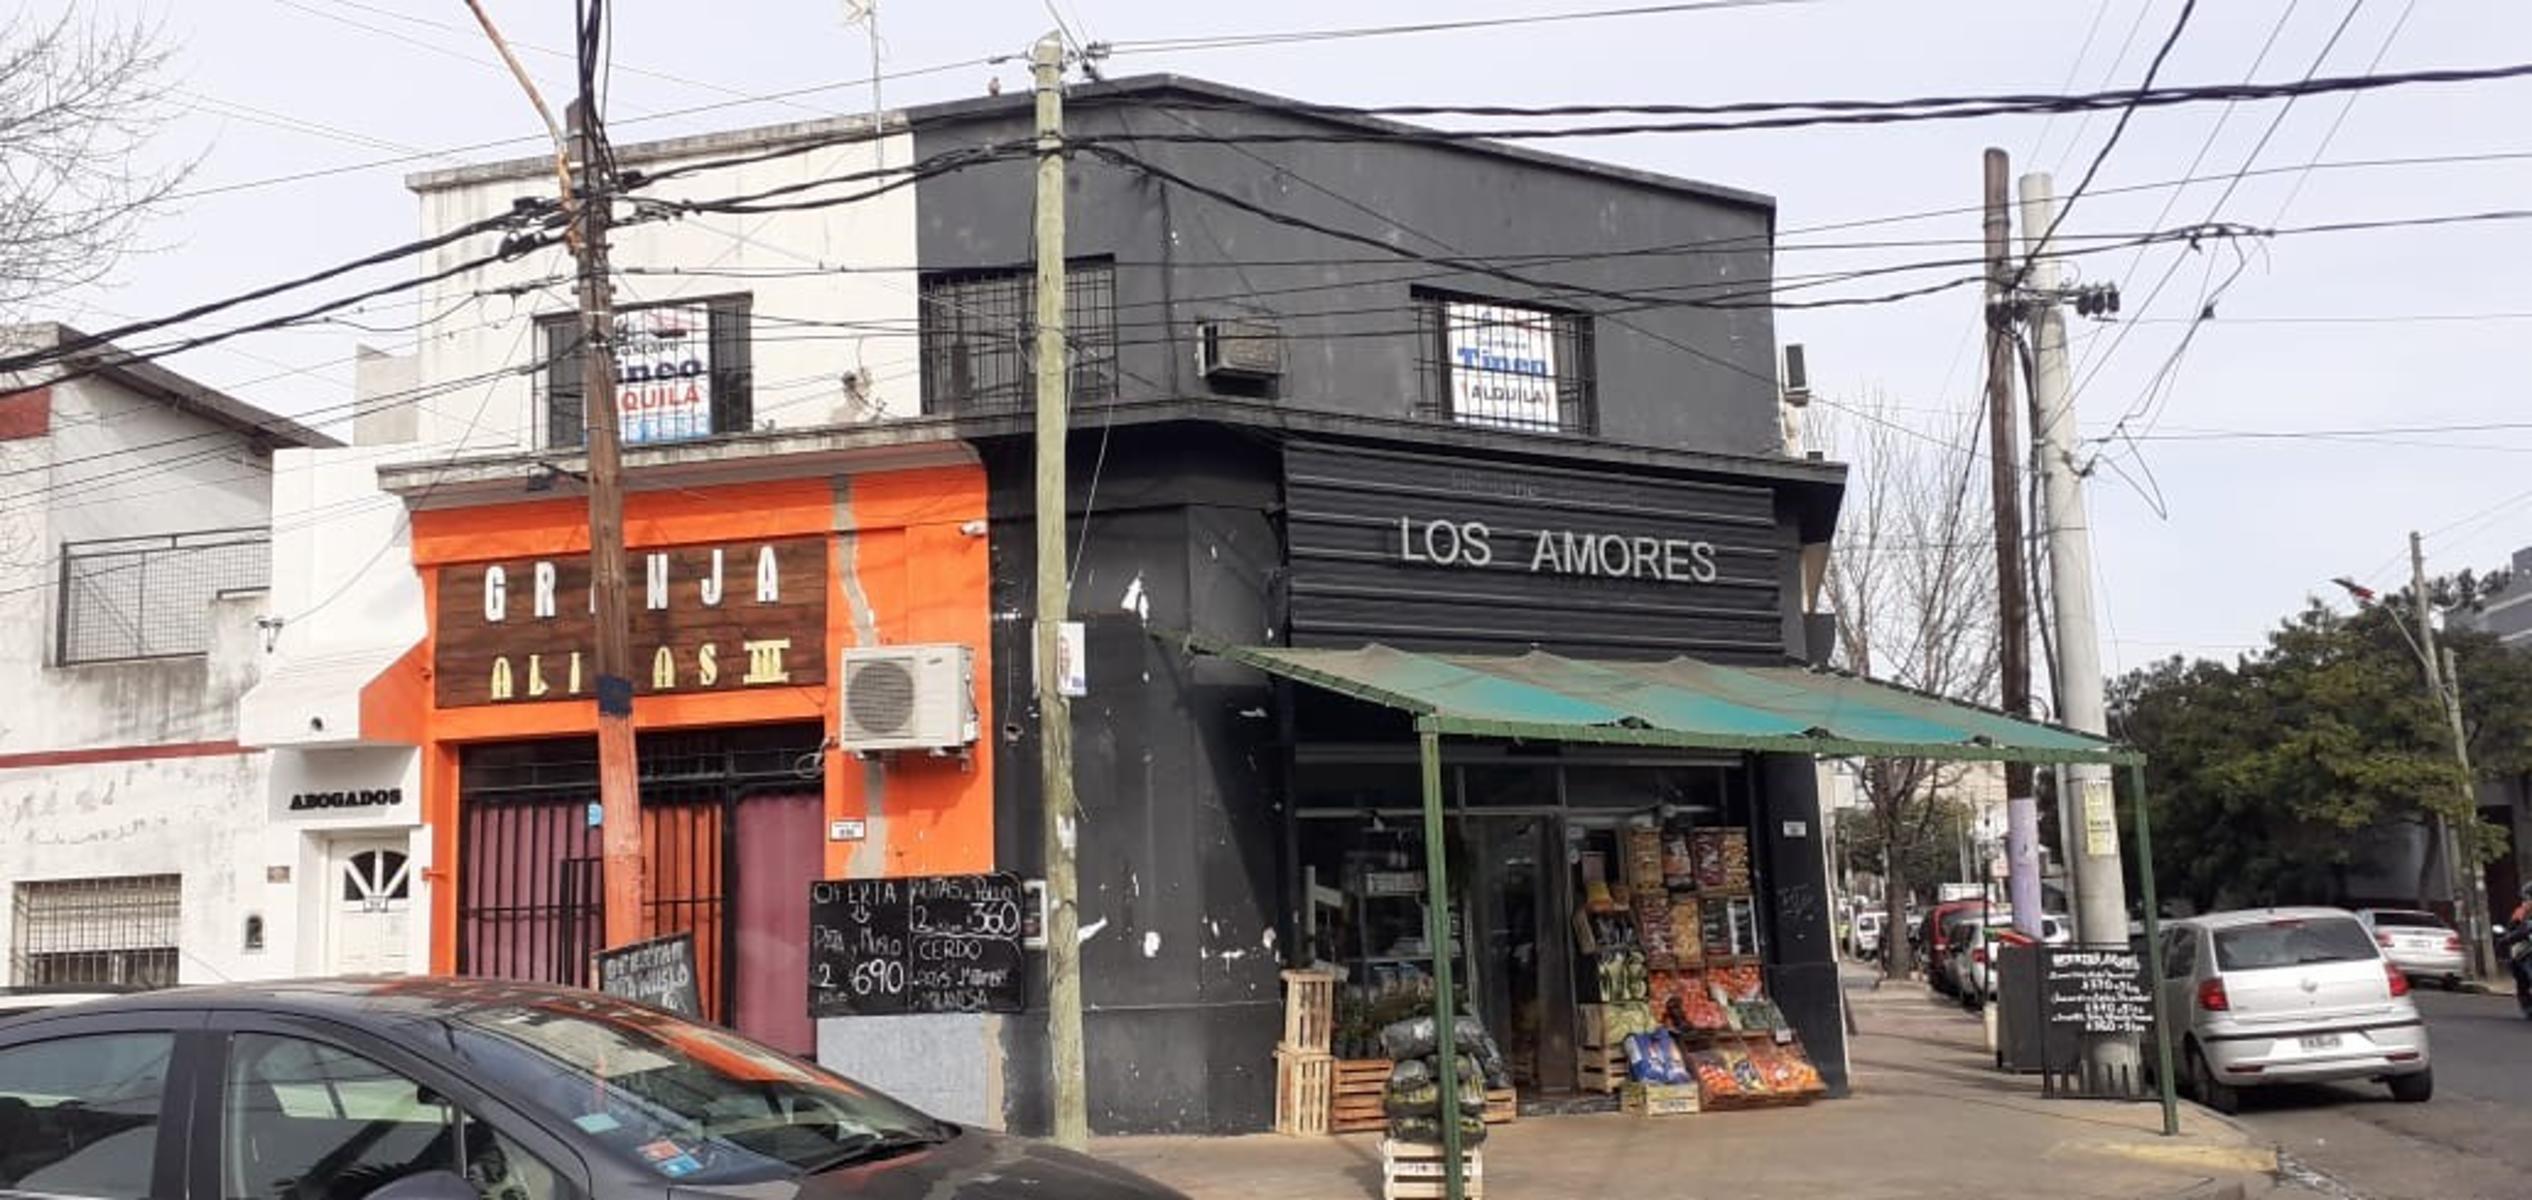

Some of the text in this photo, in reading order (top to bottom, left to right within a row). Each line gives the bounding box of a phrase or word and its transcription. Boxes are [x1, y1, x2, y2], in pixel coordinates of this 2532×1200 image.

[615, 360, 702, 383] ineo
[621, 387, 700, 412] QUILA
[1471, 385, 1543, 403] ALQUILA
[1402, 516, 1716, 582] LOS AMORES
[485, 545, 779, 621] GRNJA
[491, 638, 791, 700] ALIAS III
[289, 788, 403, 810] ABOGADOS
[920, 940, 983, 960] CERDO
[818, 962, 838, 987] 2
